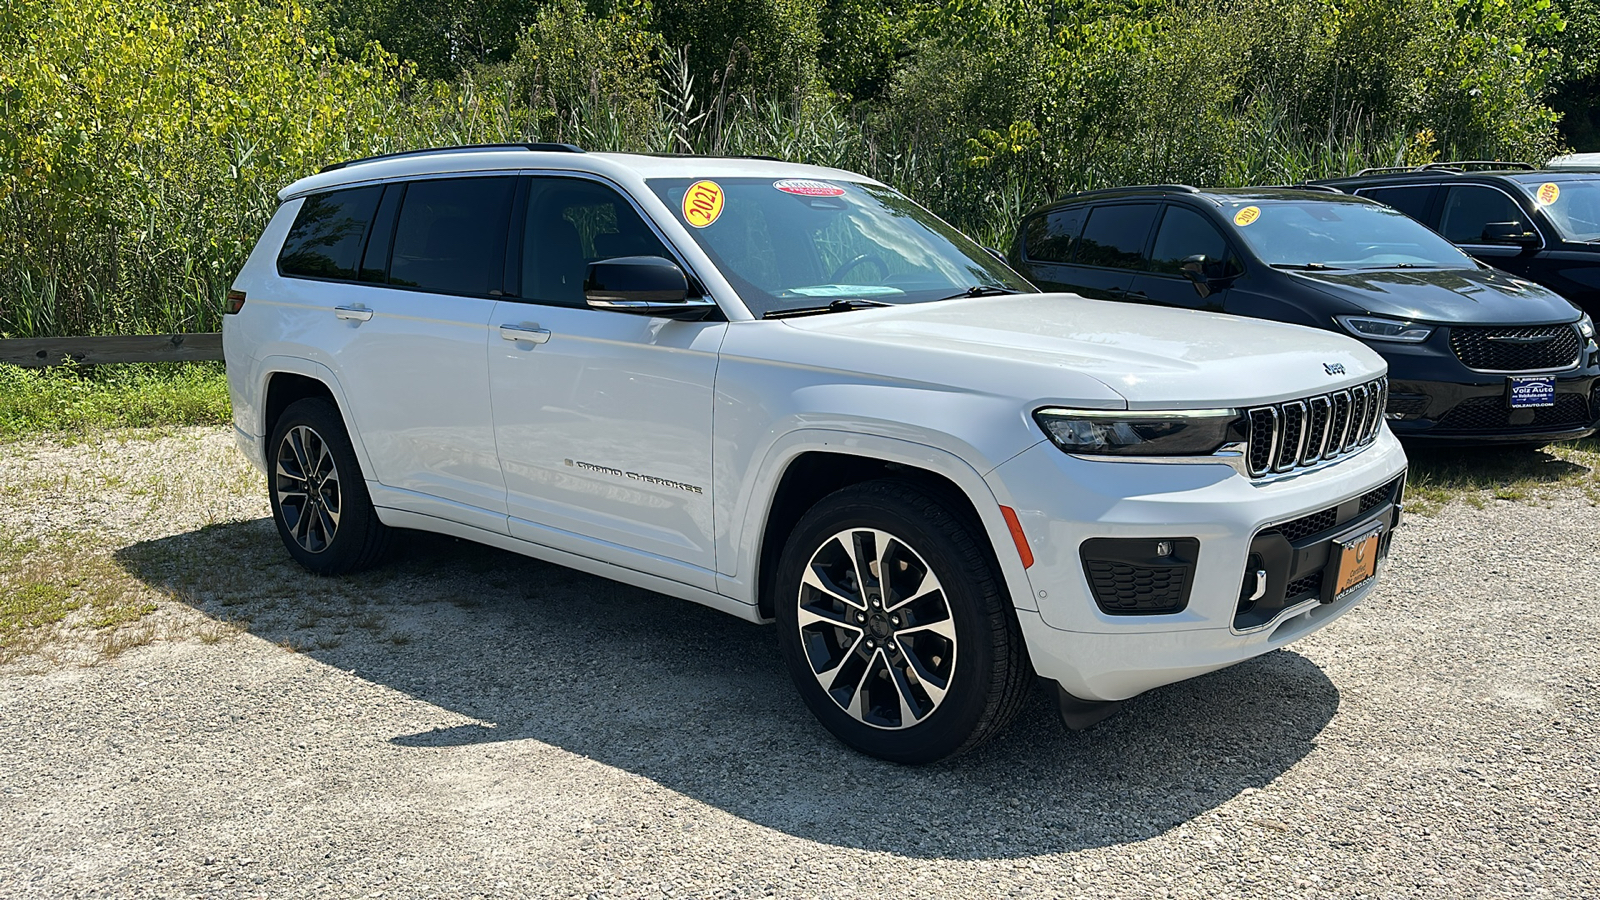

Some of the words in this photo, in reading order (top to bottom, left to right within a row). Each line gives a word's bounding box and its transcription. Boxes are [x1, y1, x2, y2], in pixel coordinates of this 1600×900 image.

[689, 185, 720, 222] 2021
[1541, 185, 1556, 204] 2015
[1238, 208, 1257, 224] 2021
[575, 460, 623, 477] GRAND
[625, 471, 703, 495] CHEROKEE
[1335, 574, 1375, 601] VOLZAUTO.COM
